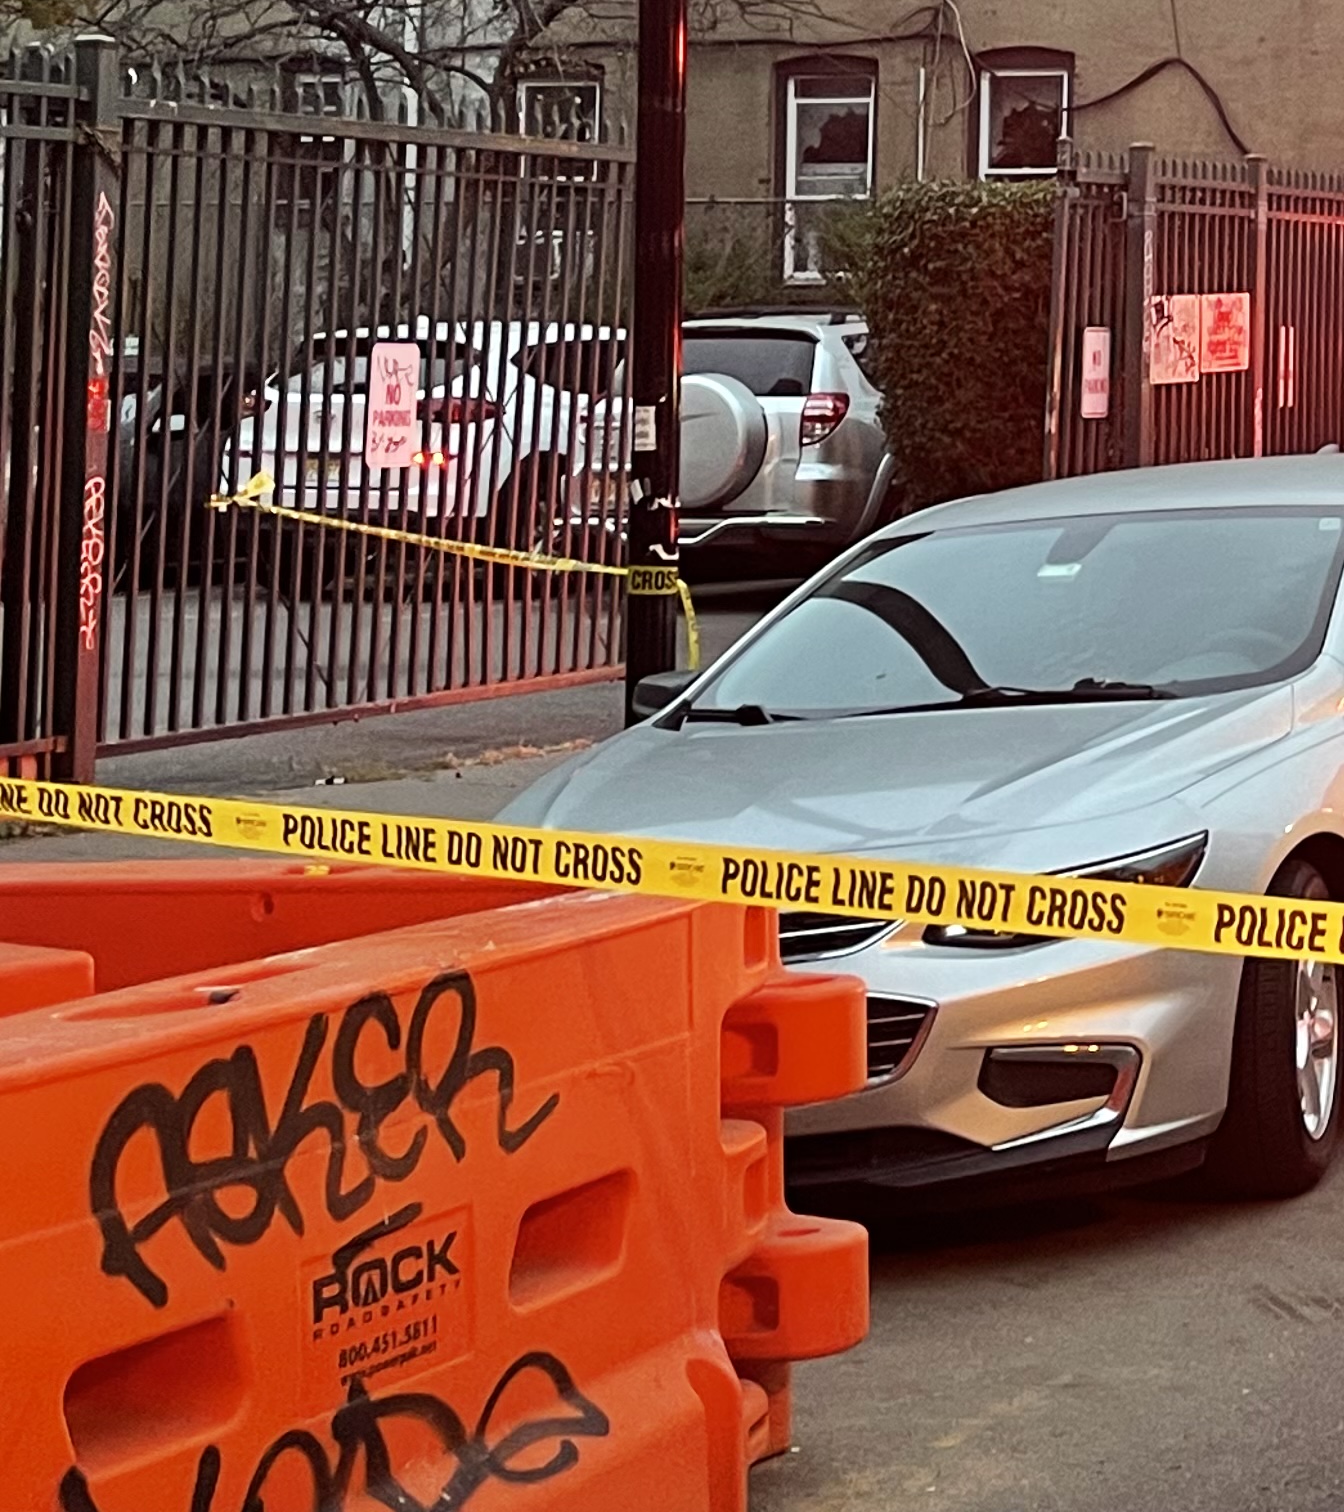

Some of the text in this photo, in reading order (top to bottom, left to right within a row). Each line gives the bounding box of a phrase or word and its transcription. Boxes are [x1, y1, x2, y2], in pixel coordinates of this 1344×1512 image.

[385, 384, 402, 405] NO
[630, 569, 679, 591] CROS
[37, 787, 70, 819] DO
[77, 791, 123, 826] NOT
[134, 798, 213, 837] CROSS
[283, 814, 371, 855] POLICE
[382, 824, 436, 862] LINE
[448, 831, 481, 867] DO
[493, 835, 542, 874] NOT
[555, 841, 642, 885] CROSS
[722, 858, 1126, 934] POLICE LINE DO NOT CROSS
[1215, 904, 1326, 952] POLICE
[312, 1229, 461, 1325] ROCK
[338, 1314, 437, 1368] 800.451.5811
